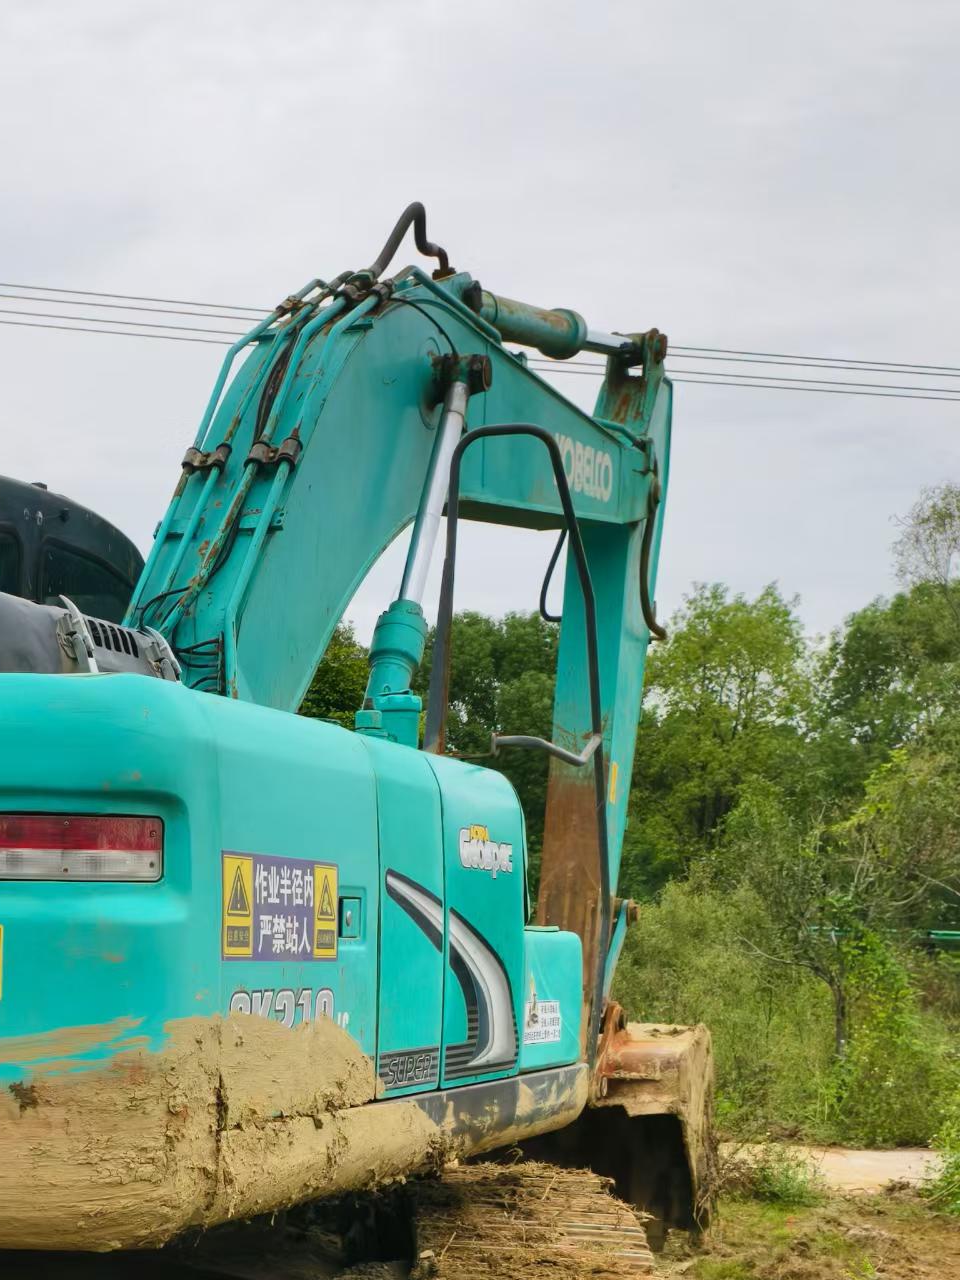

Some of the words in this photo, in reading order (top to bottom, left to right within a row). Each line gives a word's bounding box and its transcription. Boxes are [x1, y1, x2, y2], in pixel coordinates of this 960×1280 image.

[255, 863, 314, 907] 作业半径内
[258, 914, 311, 954] 严禁站人
